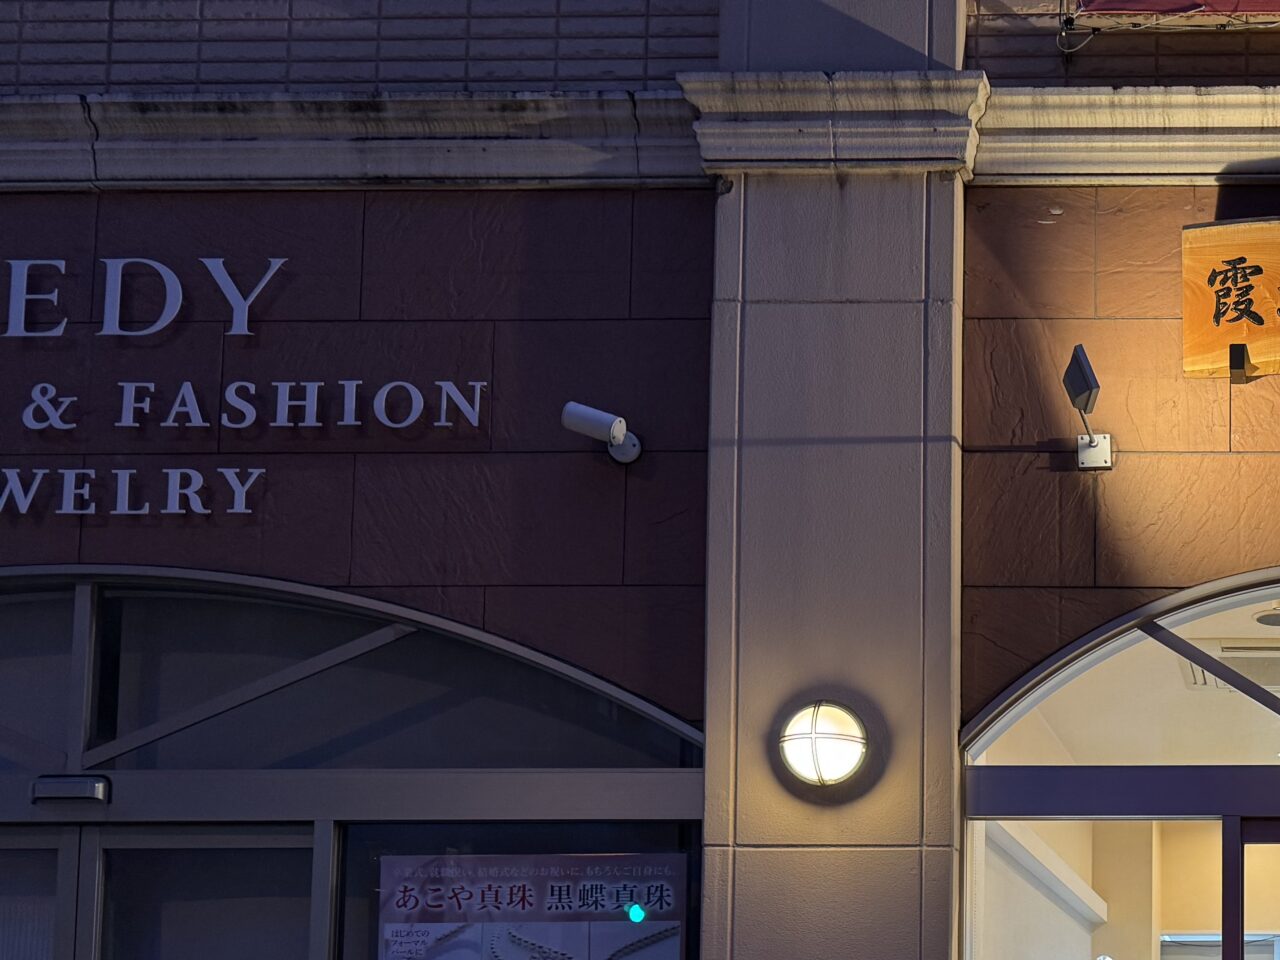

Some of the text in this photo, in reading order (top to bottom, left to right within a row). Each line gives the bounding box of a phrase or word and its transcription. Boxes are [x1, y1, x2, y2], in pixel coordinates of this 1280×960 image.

[2, 257, 289, 338] EDY
[22, 380, 488, 430] & FASHION
[395, 884, 673, 912] あこや真珠 黒蝶真珠
